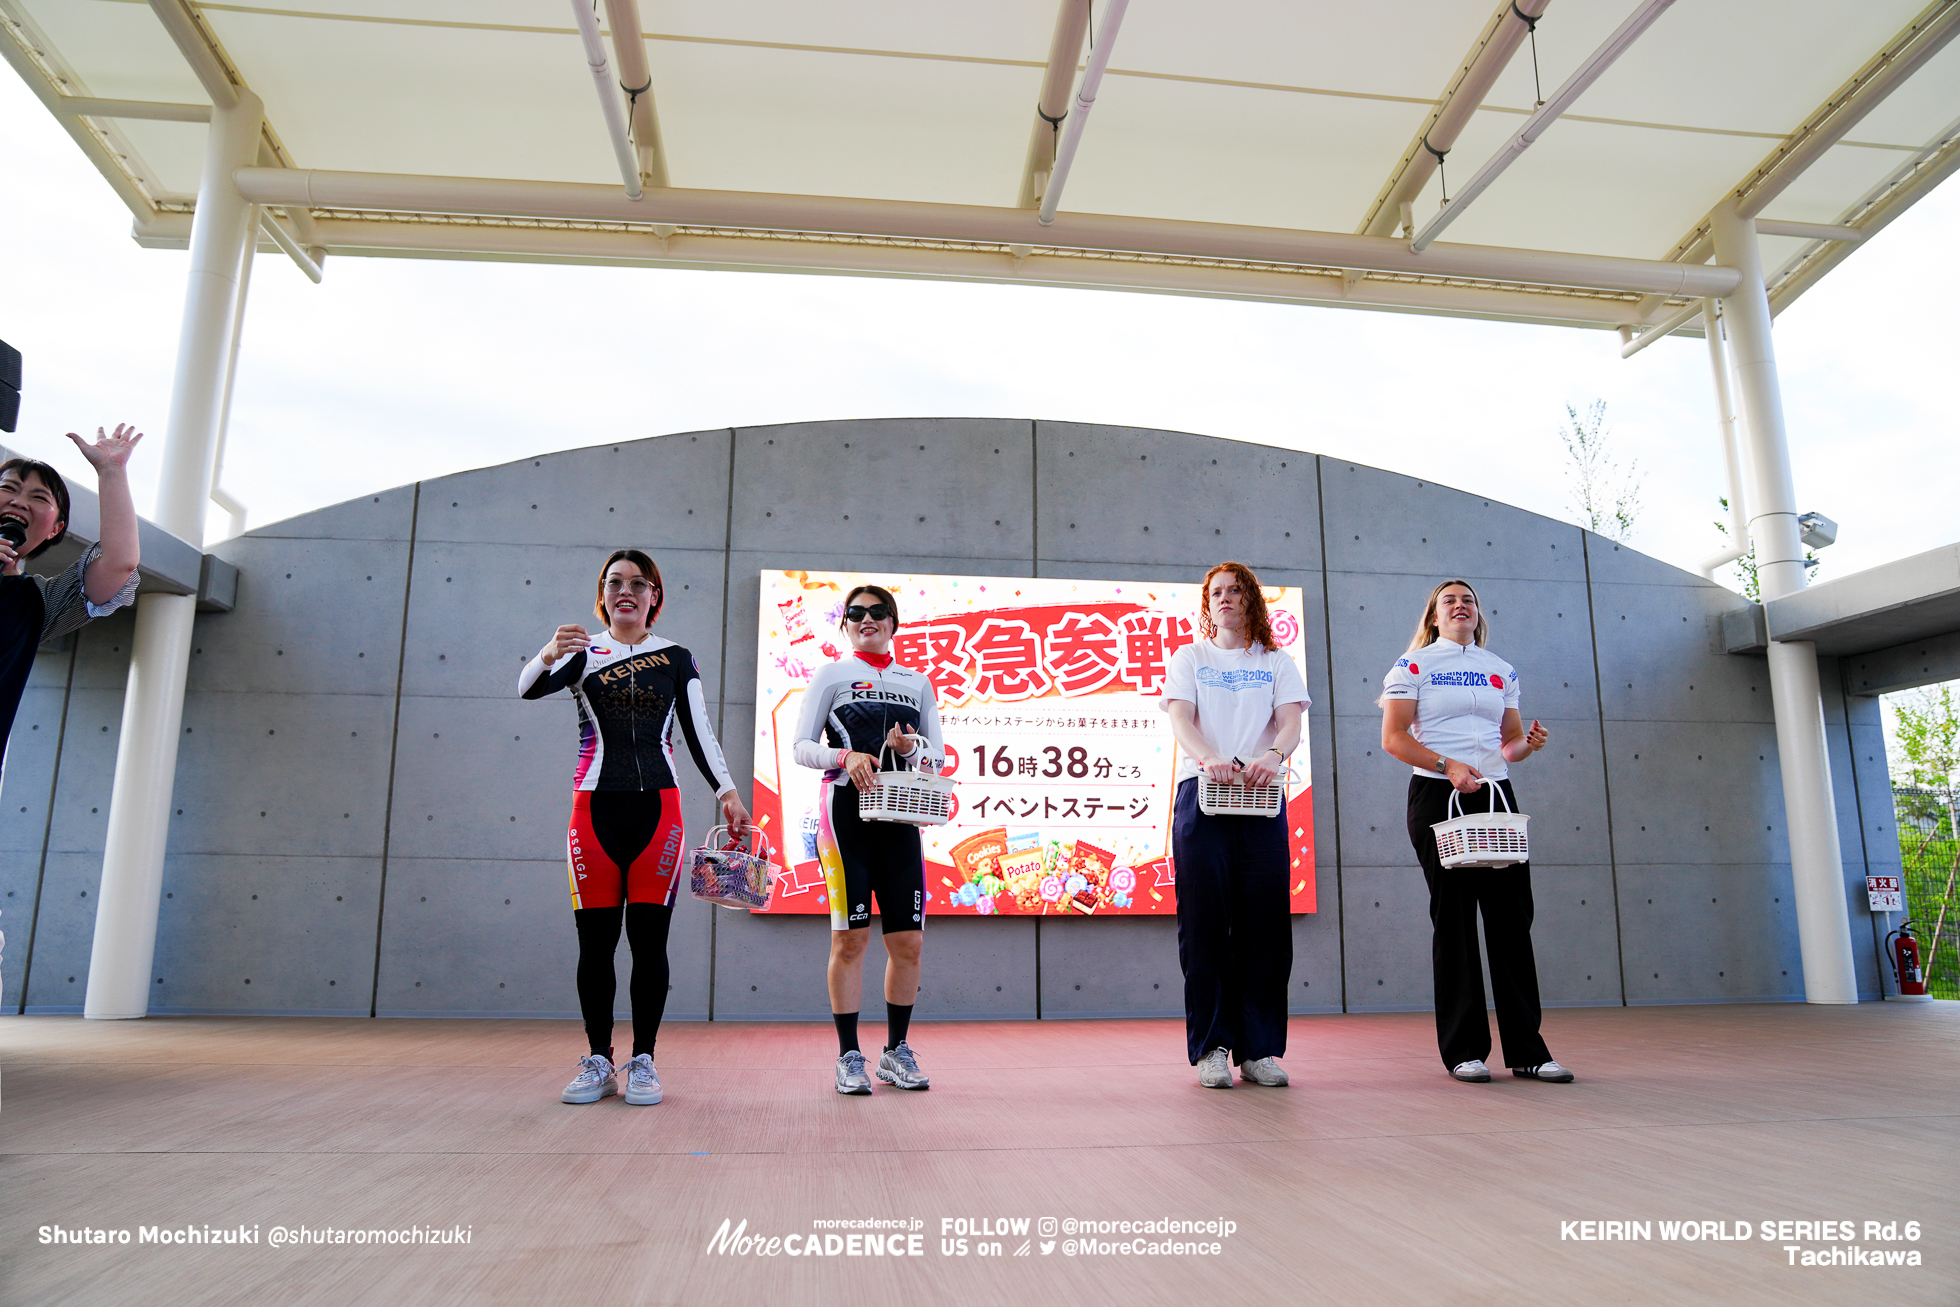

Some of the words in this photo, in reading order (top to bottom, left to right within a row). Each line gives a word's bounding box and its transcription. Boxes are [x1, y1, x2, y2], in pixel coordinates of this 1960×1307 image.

[592, 654, 615, 668] Queen
[893, 614, 1194, 700] 緊急参戦
[598, 653, 670, 685] KEIRIN
[1249, 670, 1273, 682] 2026
[1463, 671, 1488, 686] 2026
[852, 690, 919, 707] KEIRIN
[972, 744, 1142, 779] 16時38分ごろ
[972, 795, 1149, 819] イベントステージ
[655, 823, 683, 877] KEIRIN
[966, 845, 1002, 865] Cookies
[1006, 860, 1041, 878] Potato
